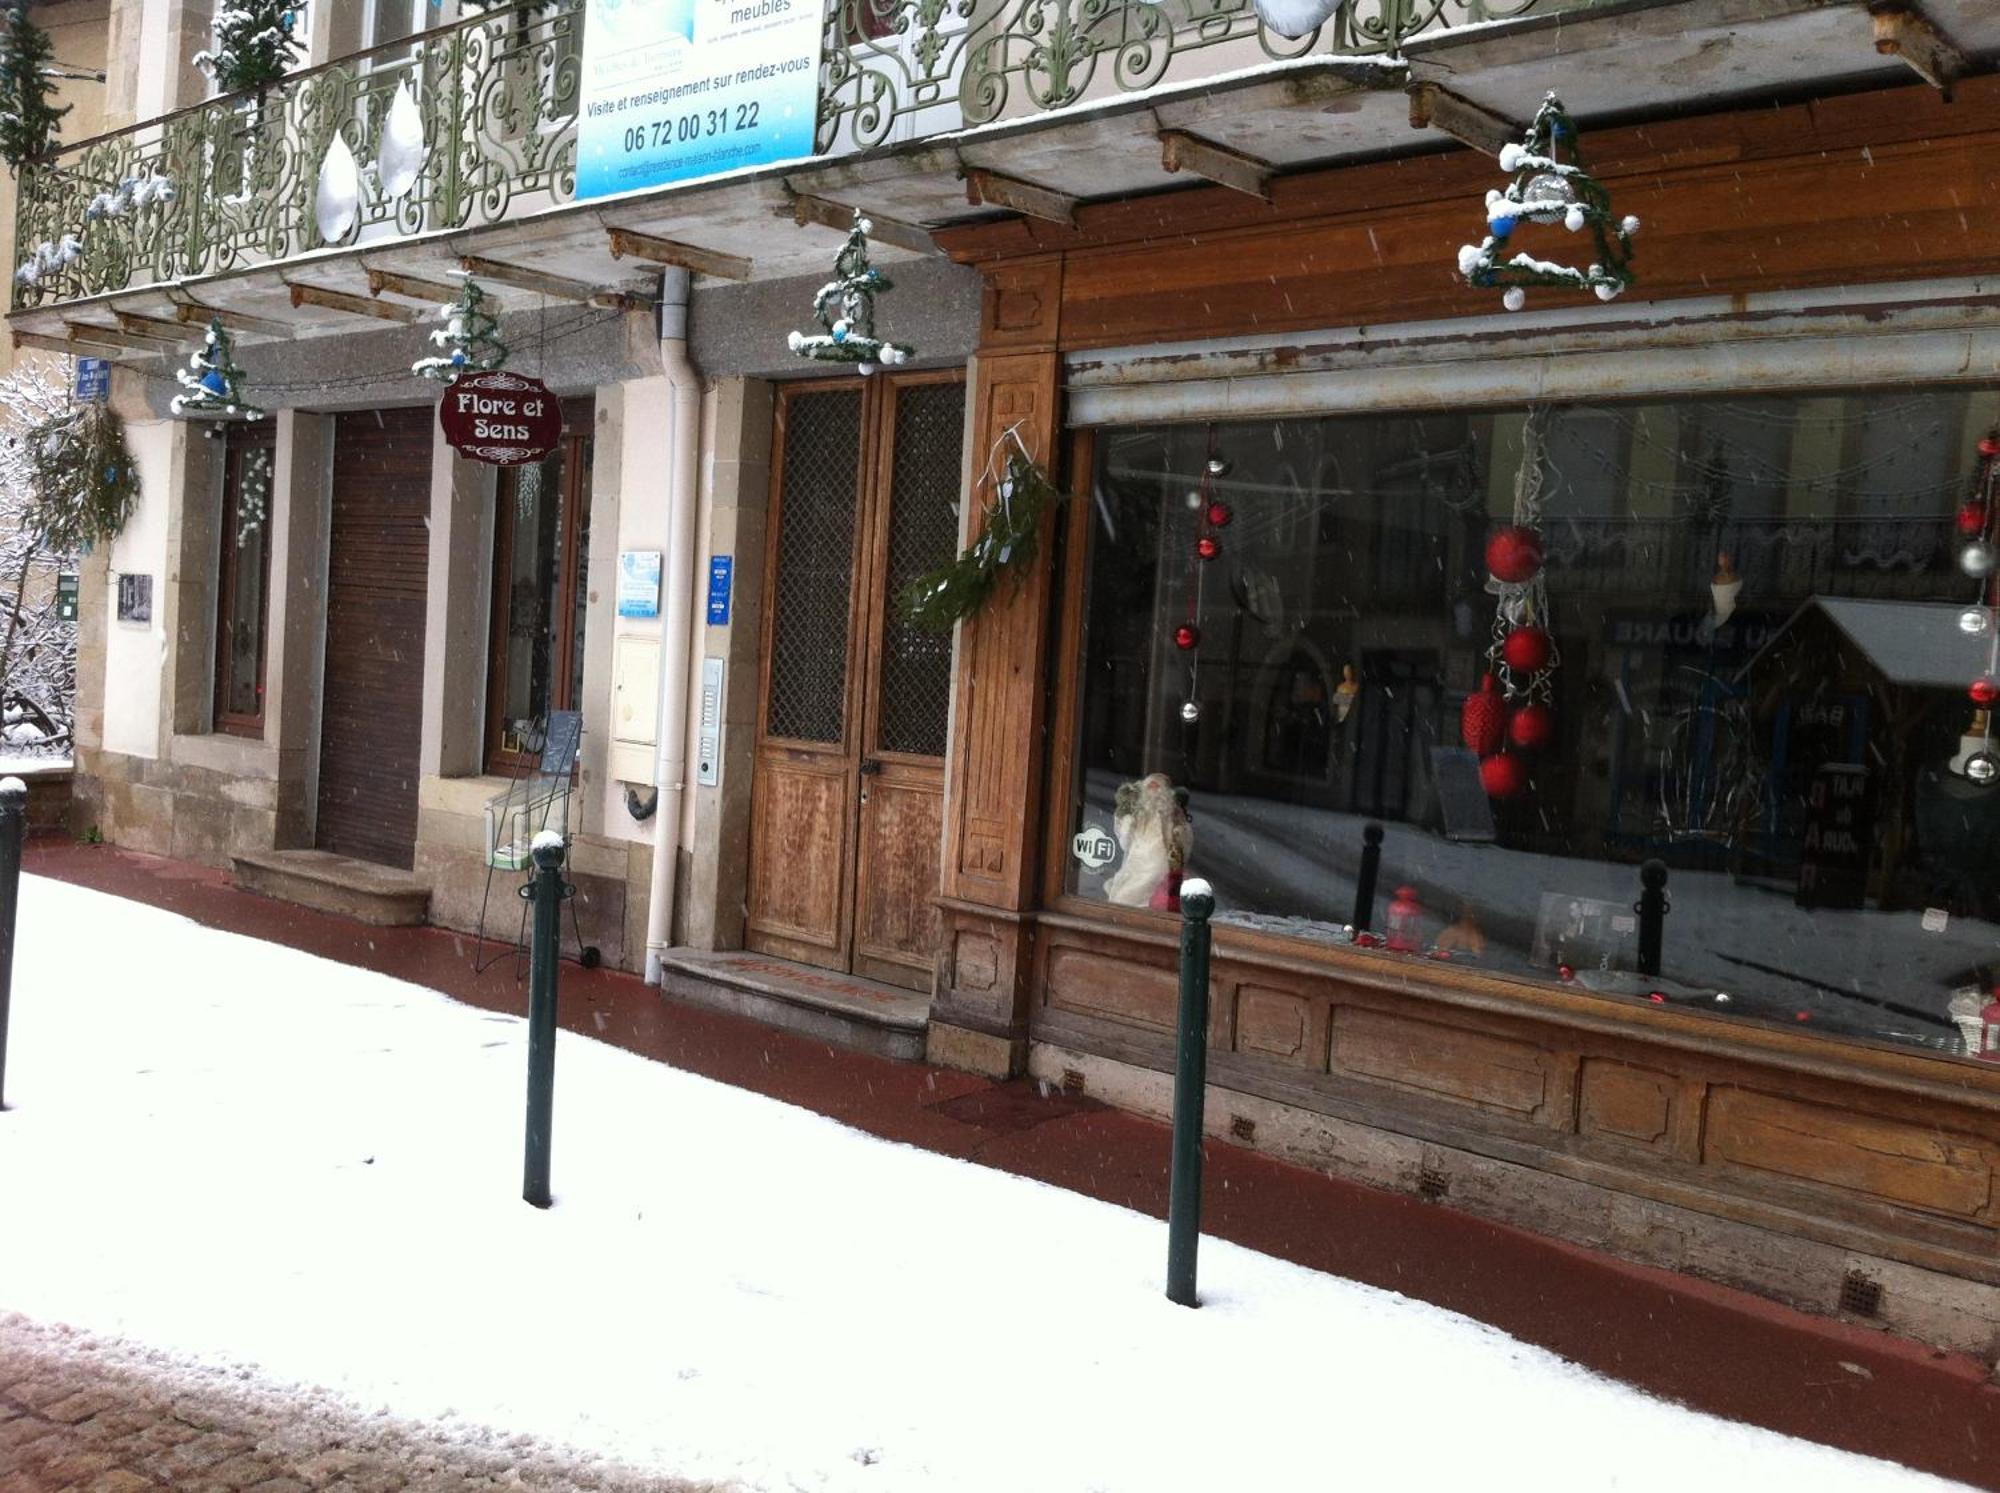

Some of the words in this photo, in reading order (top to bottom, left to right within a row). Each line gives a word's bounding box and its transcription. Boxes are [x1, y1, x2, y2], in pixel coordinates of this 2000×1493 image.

[587, 100, 616, 118] Visite
[620, 96, 627, 112] et
[630, 77, 710, 105] renseignement
[713, 73, 732, 90] sur
[735, 56, 811, 84] rendez-vous
[624, 126, 645, 153] 06
[652, 119, 672, 148] 72
[678, 113, 700, 141] 00
[706, 108, 727, 137] 31
[736, 101, 760, 131] 22
[457, 393, 516, 416] Flore
[523, 398, 544, 417] et
[474, 418, 530, 440] Sens
